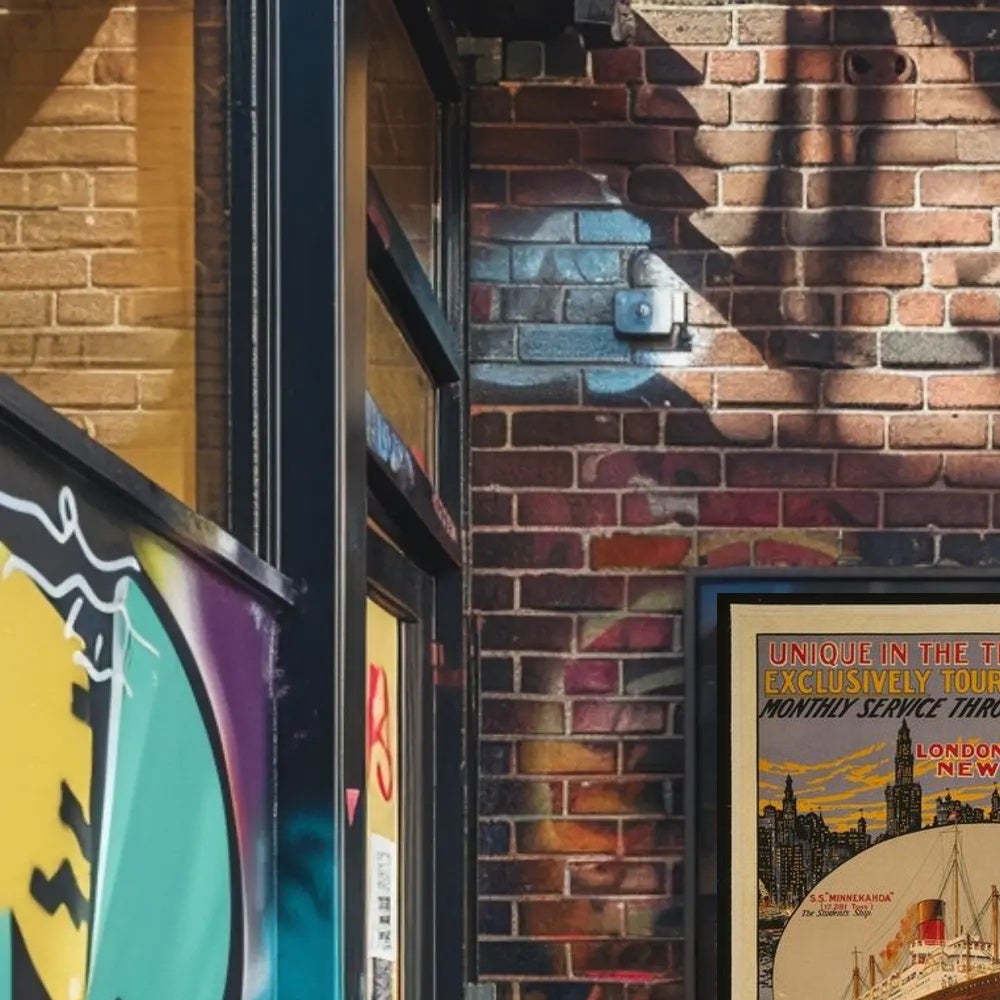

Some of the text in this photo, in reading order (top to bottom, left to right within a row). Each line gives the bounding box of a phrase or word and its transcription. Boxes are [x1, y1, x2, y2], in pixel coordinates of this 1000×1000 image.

[769, 642, 872, 668] UNIQUE
[881, 642, 907, 666] IN
[918, 642, 969, 666] THE
[764, 668, 931, 696] EXCLUSIVELY
[758, 698, 858, 719] MONTHLY
[857, 698, 944, 719] SERVICE
[935, 761, 1000, 779] NEW
